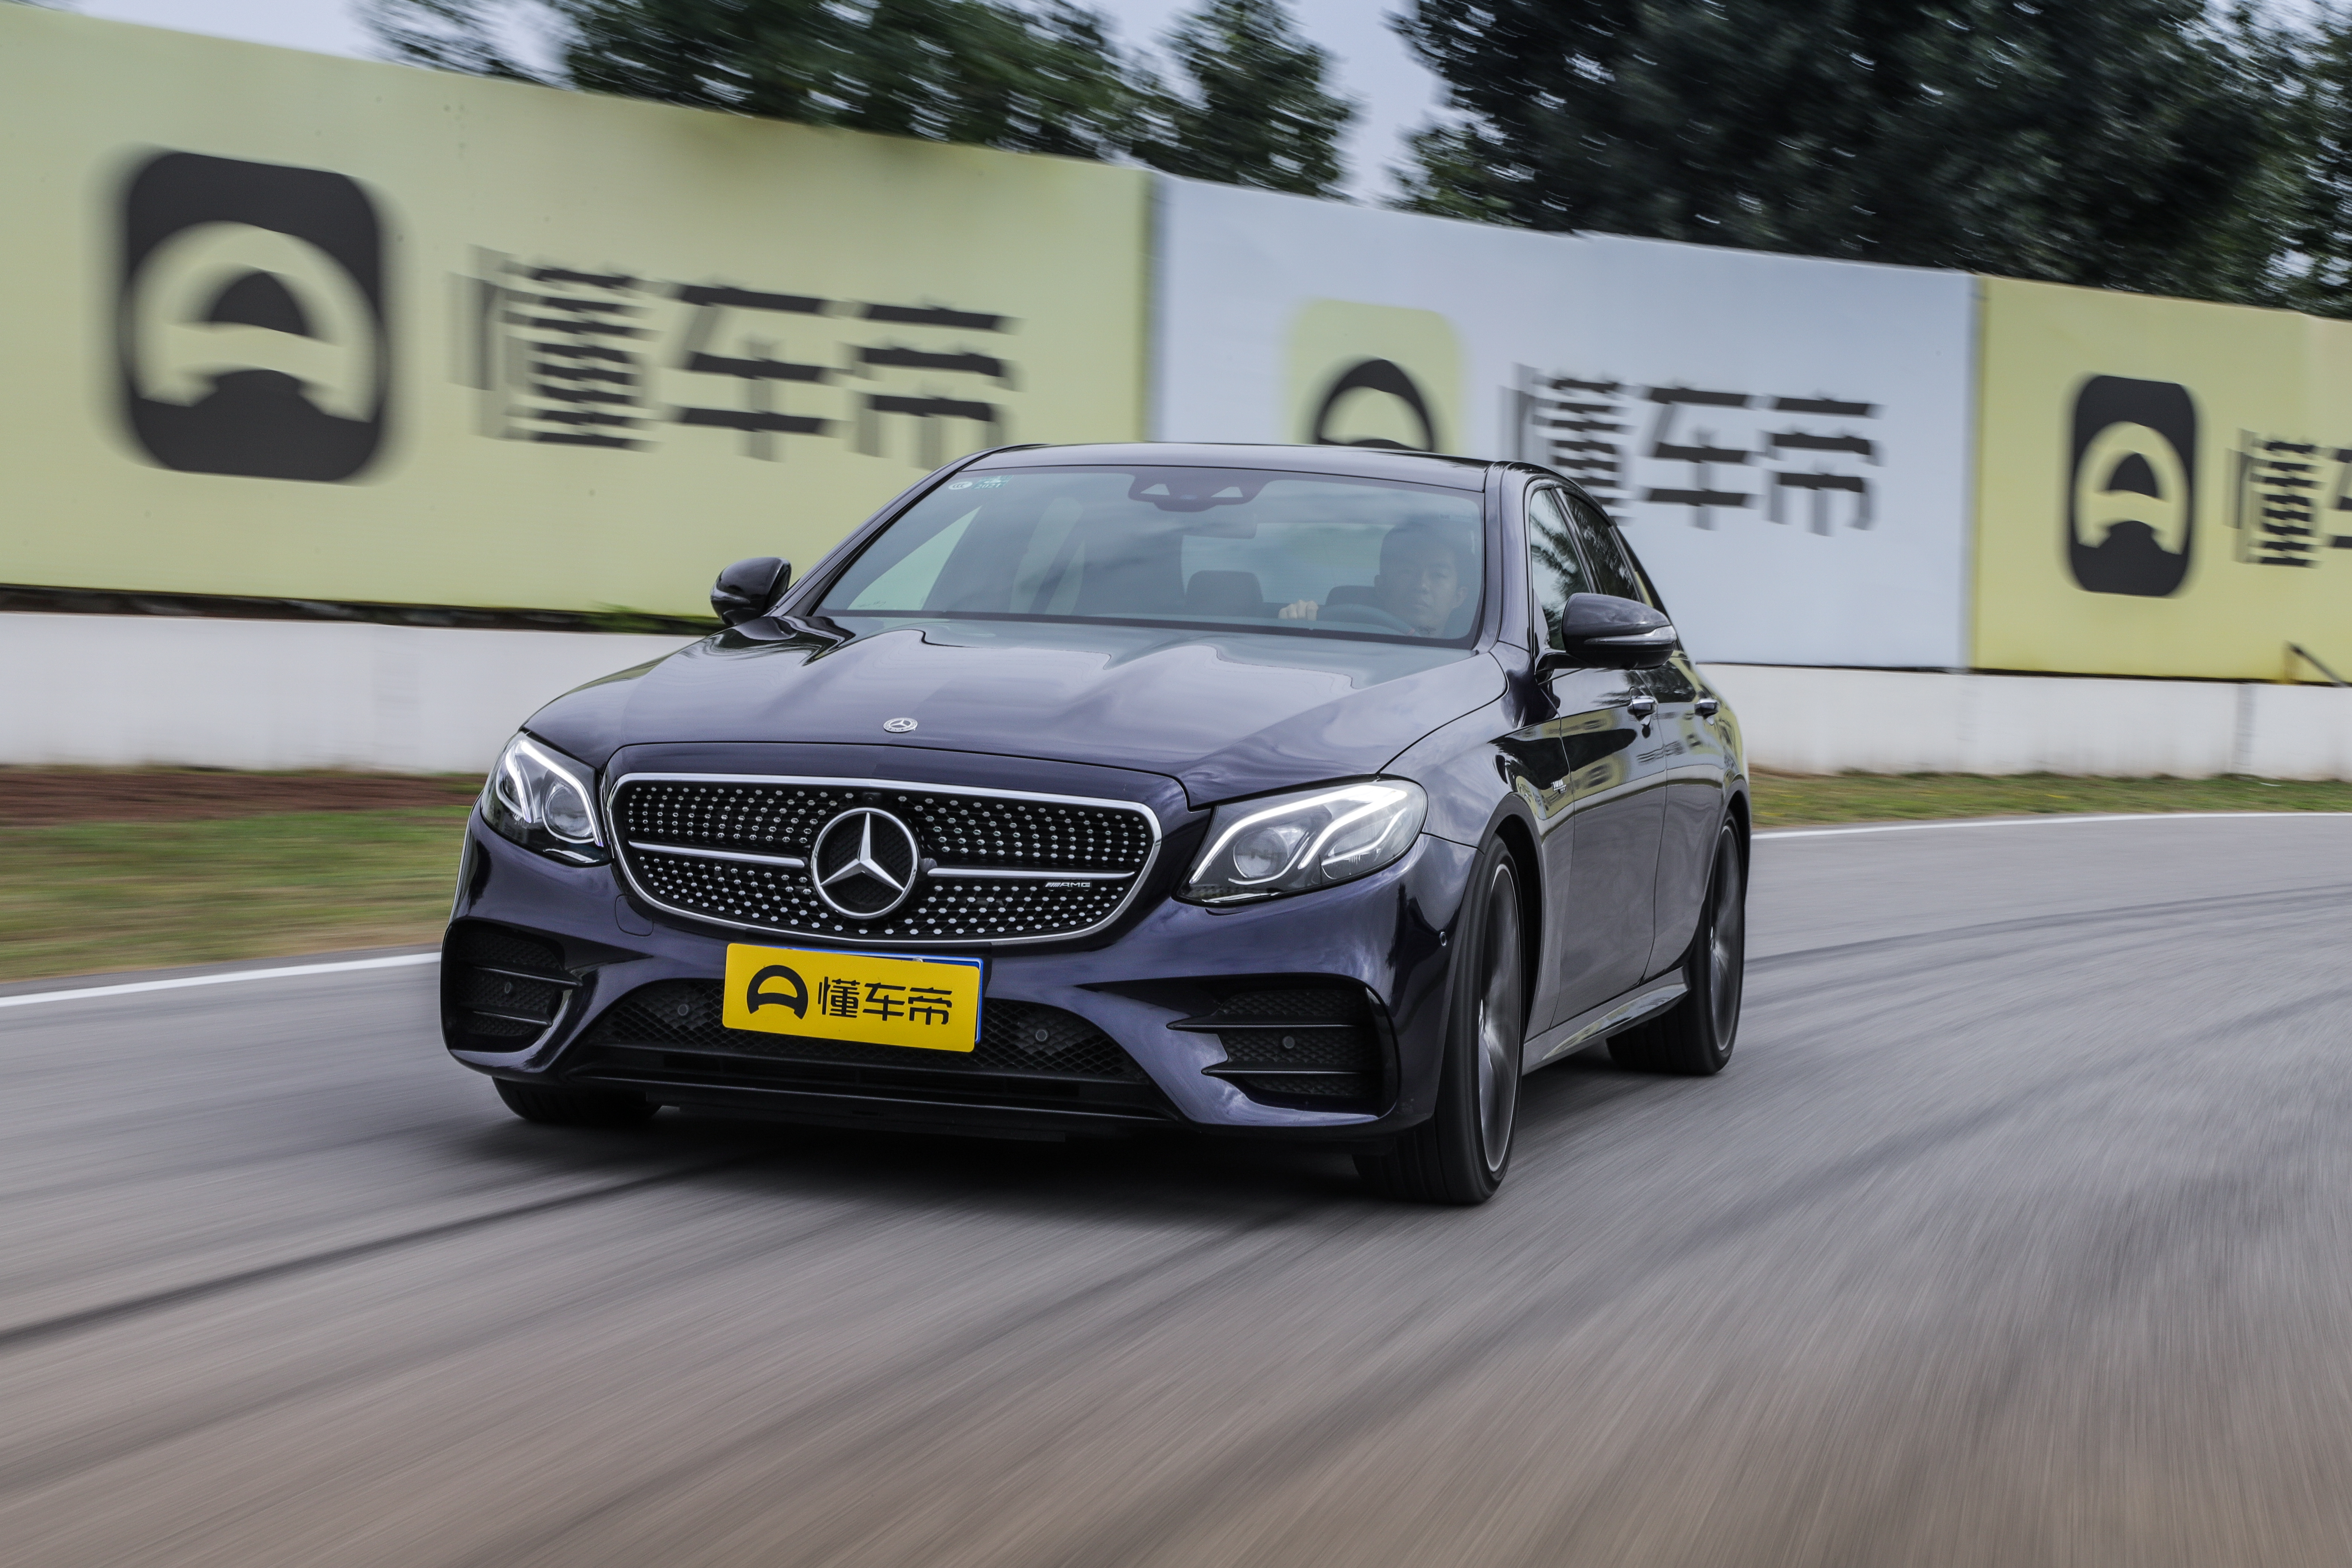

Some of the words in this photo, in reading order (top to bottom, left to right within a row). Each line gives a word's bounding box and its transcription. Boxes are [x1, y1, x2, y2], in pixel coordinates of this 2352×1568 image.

[449, 245, 1022, 470] 懂车帝
[1501, 364, 1886, 535] 懂车帝
[818, 976, 952, 1025] 懂车帝
